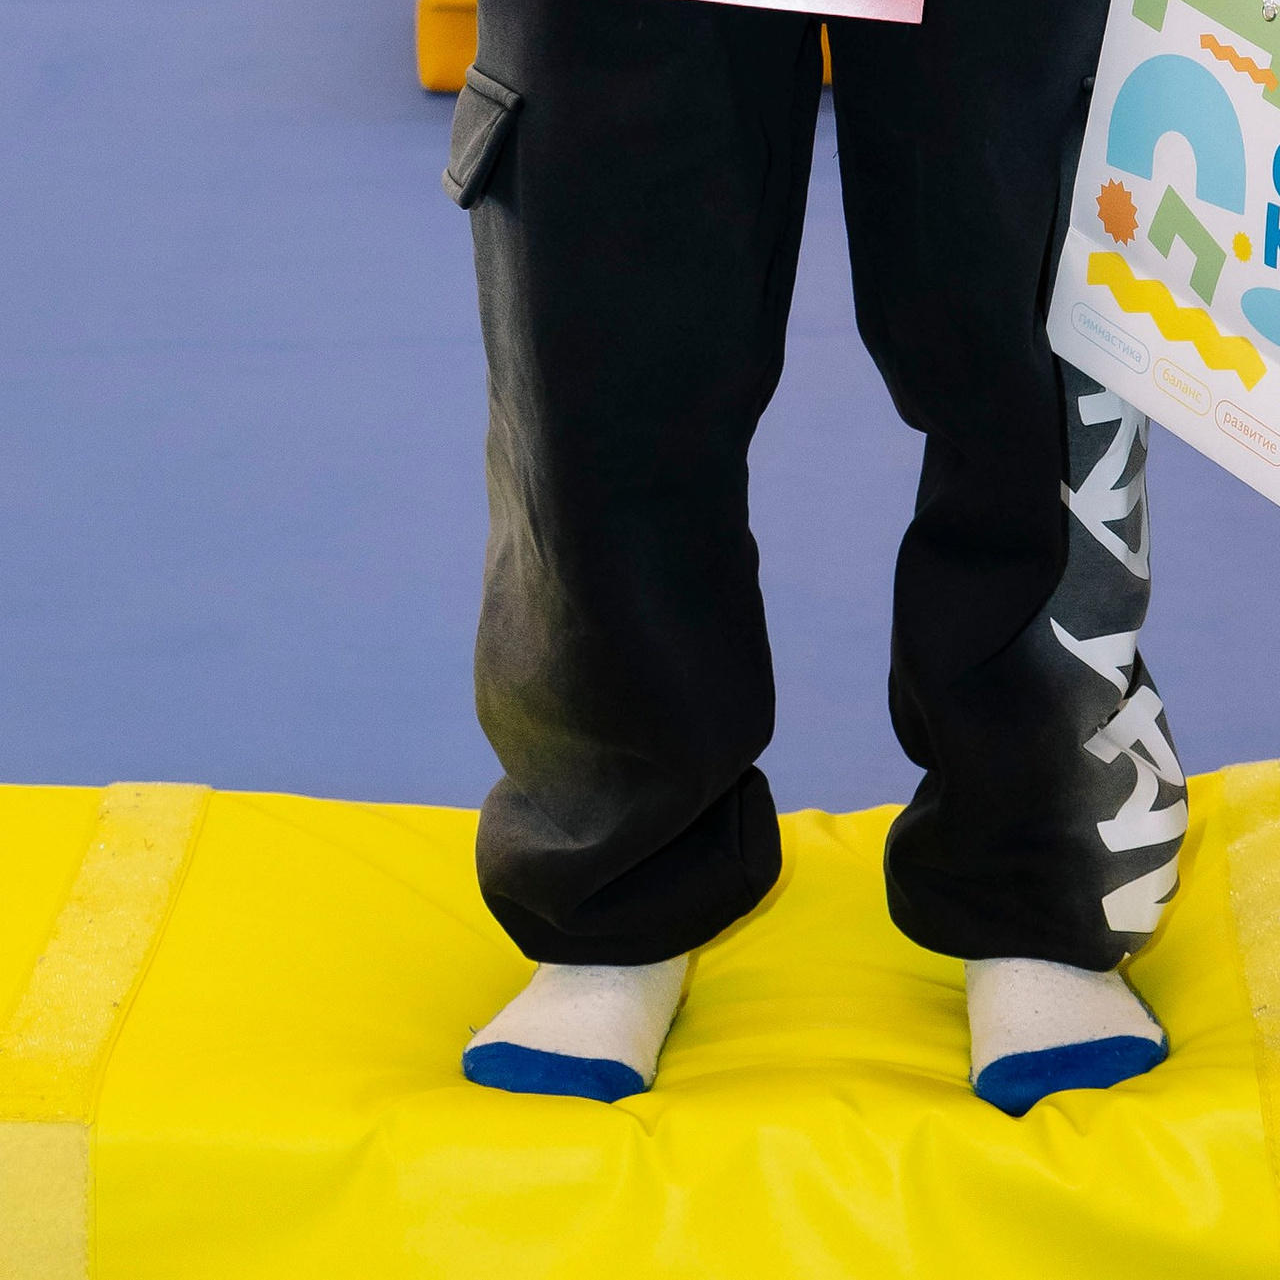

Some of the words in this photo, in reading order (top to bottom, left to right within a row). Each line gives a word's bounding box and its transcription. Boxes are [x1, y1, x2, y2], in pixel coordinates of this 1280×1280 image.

[1078, 312, 1143, 363] гимнастика
[1162, 367, 1203, 405] баланс
[1223, 411, 1278, 455] развитие
